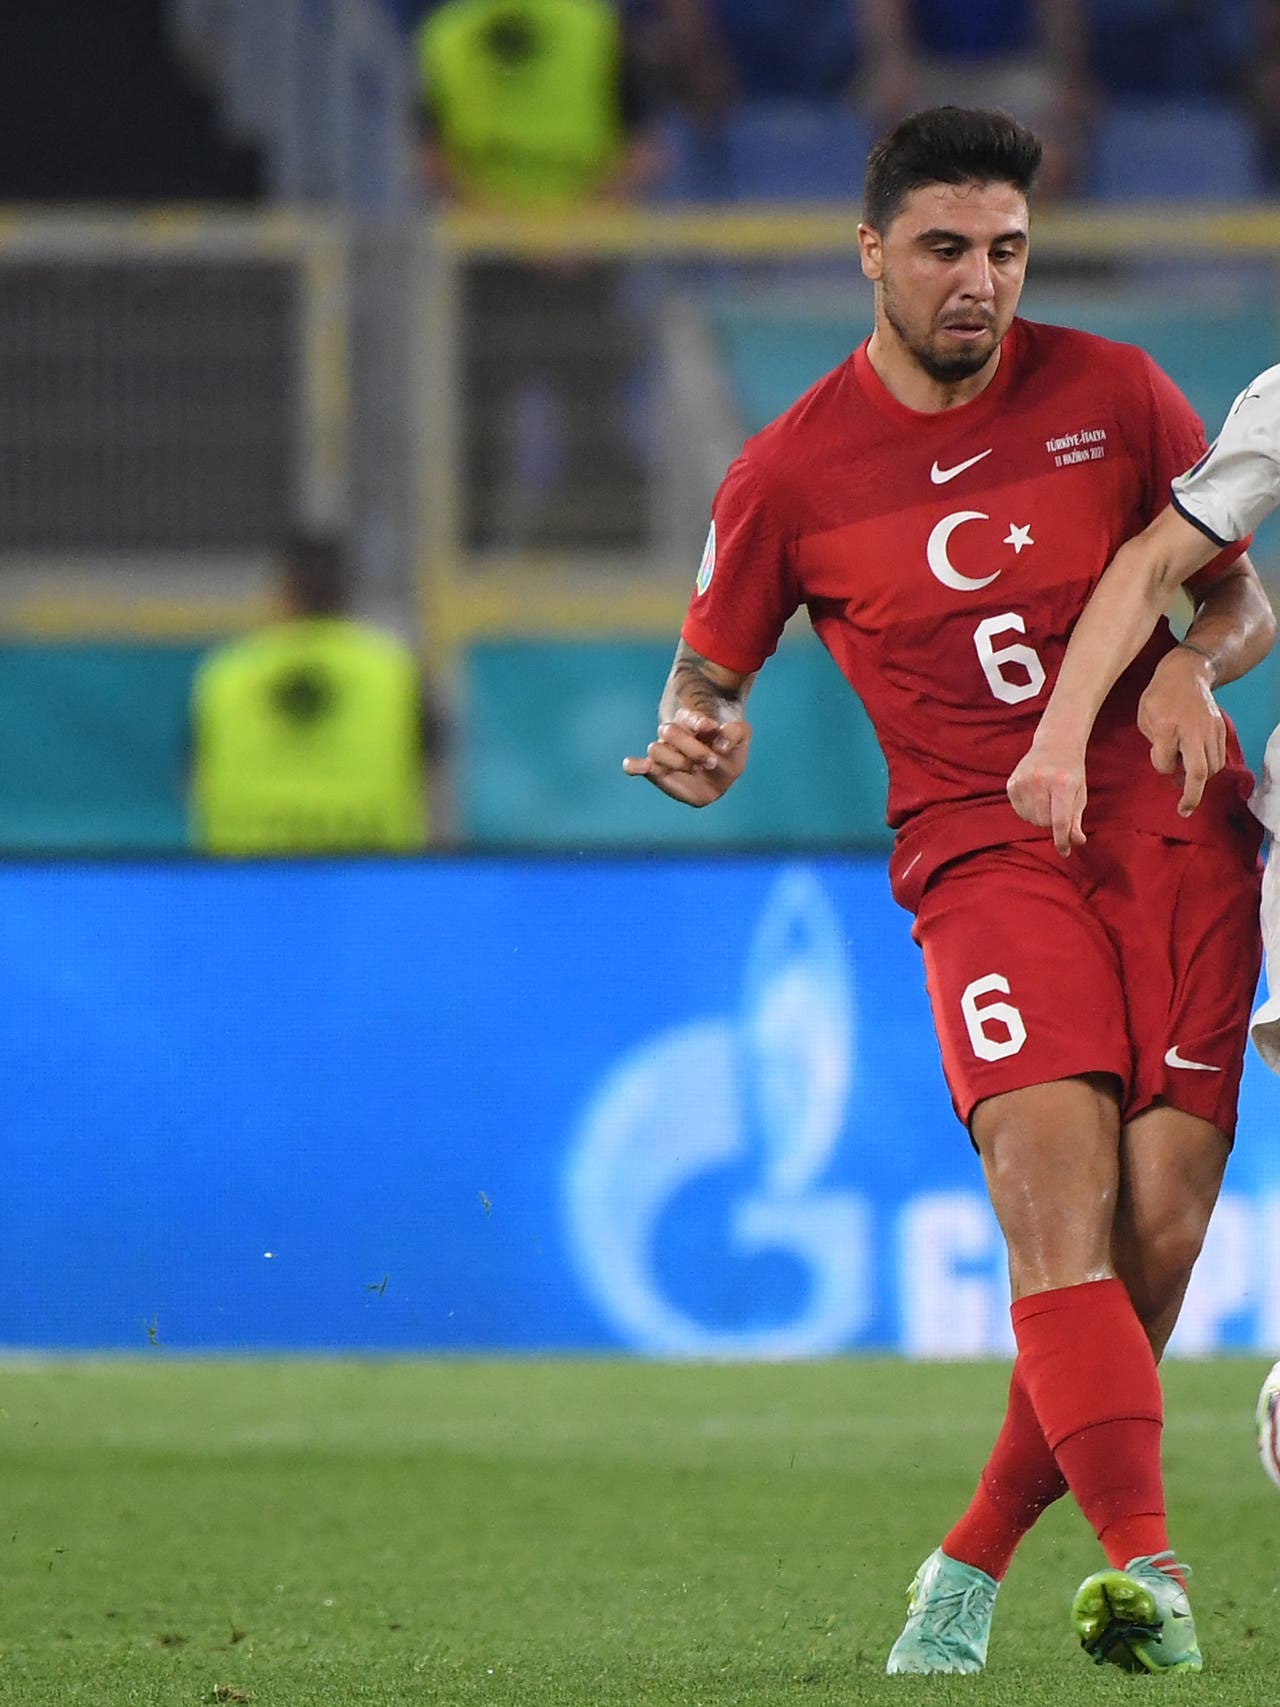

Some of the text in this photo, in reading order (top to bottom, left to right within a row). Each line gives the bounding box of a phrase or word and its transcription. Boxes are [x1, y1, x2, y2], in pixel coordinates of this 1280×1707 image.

[1089, 446, 1105, 460] 2021
[973, 611, 1047, 706] 6
[960, 971, 1028, 1063] 6
